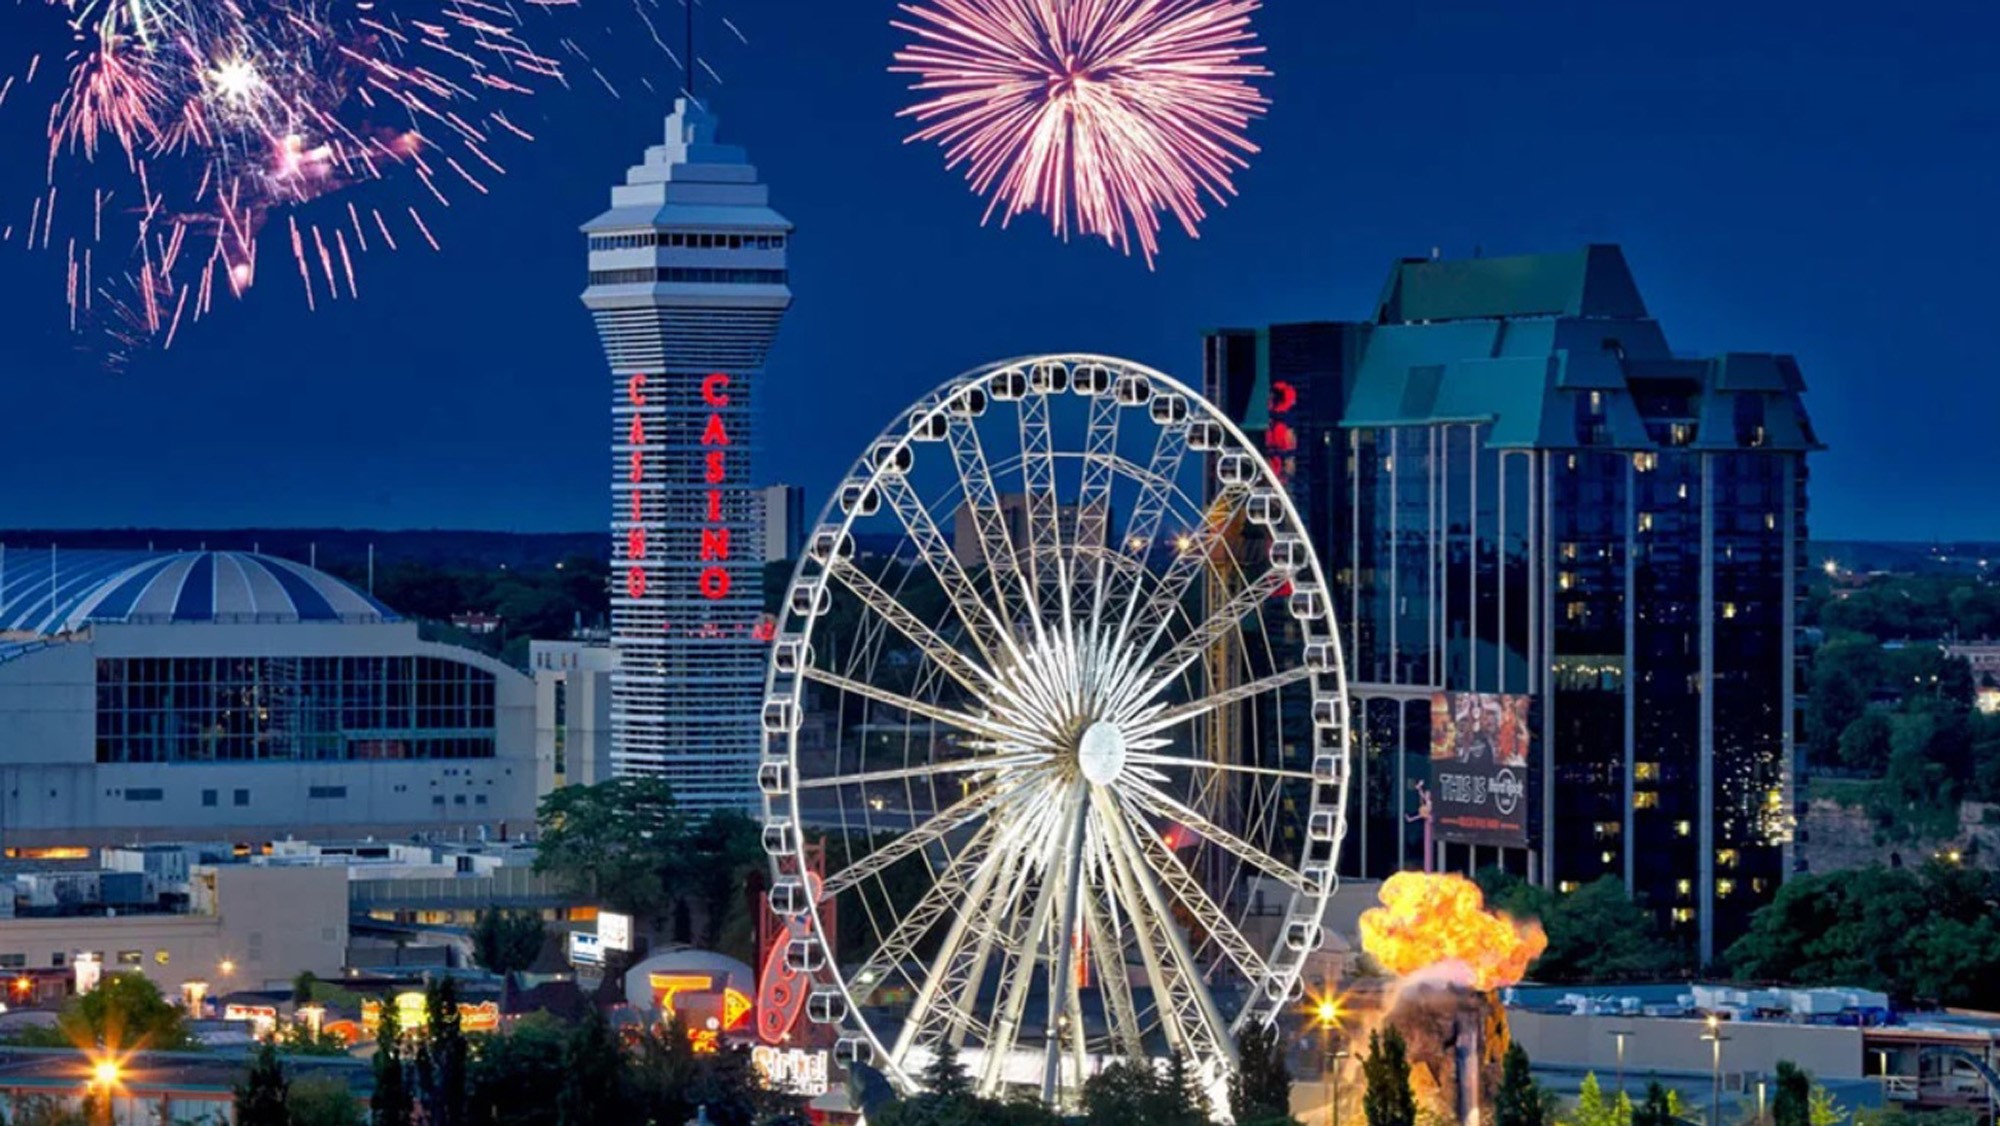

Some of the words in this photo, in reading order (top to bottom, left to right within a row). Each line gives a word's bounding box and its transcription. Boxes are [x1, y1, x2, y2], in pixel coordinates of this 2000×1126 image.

[628, 373, 646, 599] CASINO
[699, 373, 732, 600] CASINO
[1439, 773, 1471, 803] THIS
[1472, 775, 1487, 804] IS
